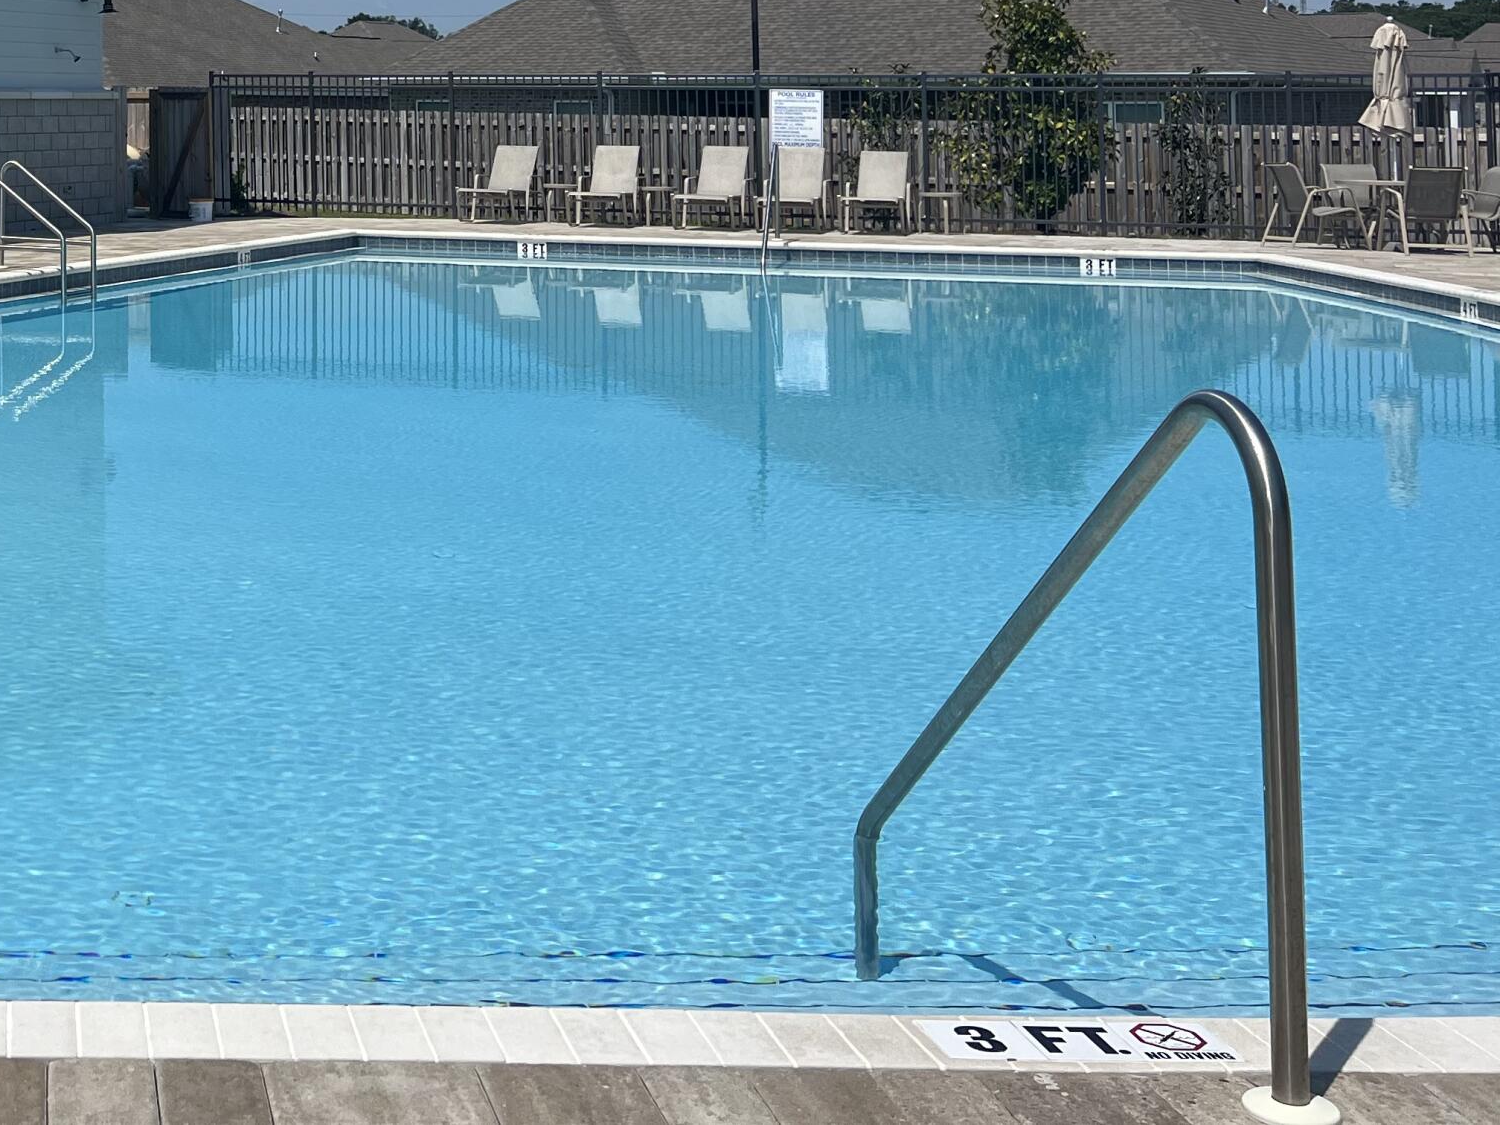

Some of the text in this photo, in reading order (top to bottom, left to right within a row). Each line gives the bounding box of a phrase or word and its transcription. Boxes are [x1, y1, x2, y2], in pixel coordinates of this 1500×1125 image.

[953, 1025, 1132, 1055] 3 FT.
[1144, 1051, 1237, 1060] NO DIVING
